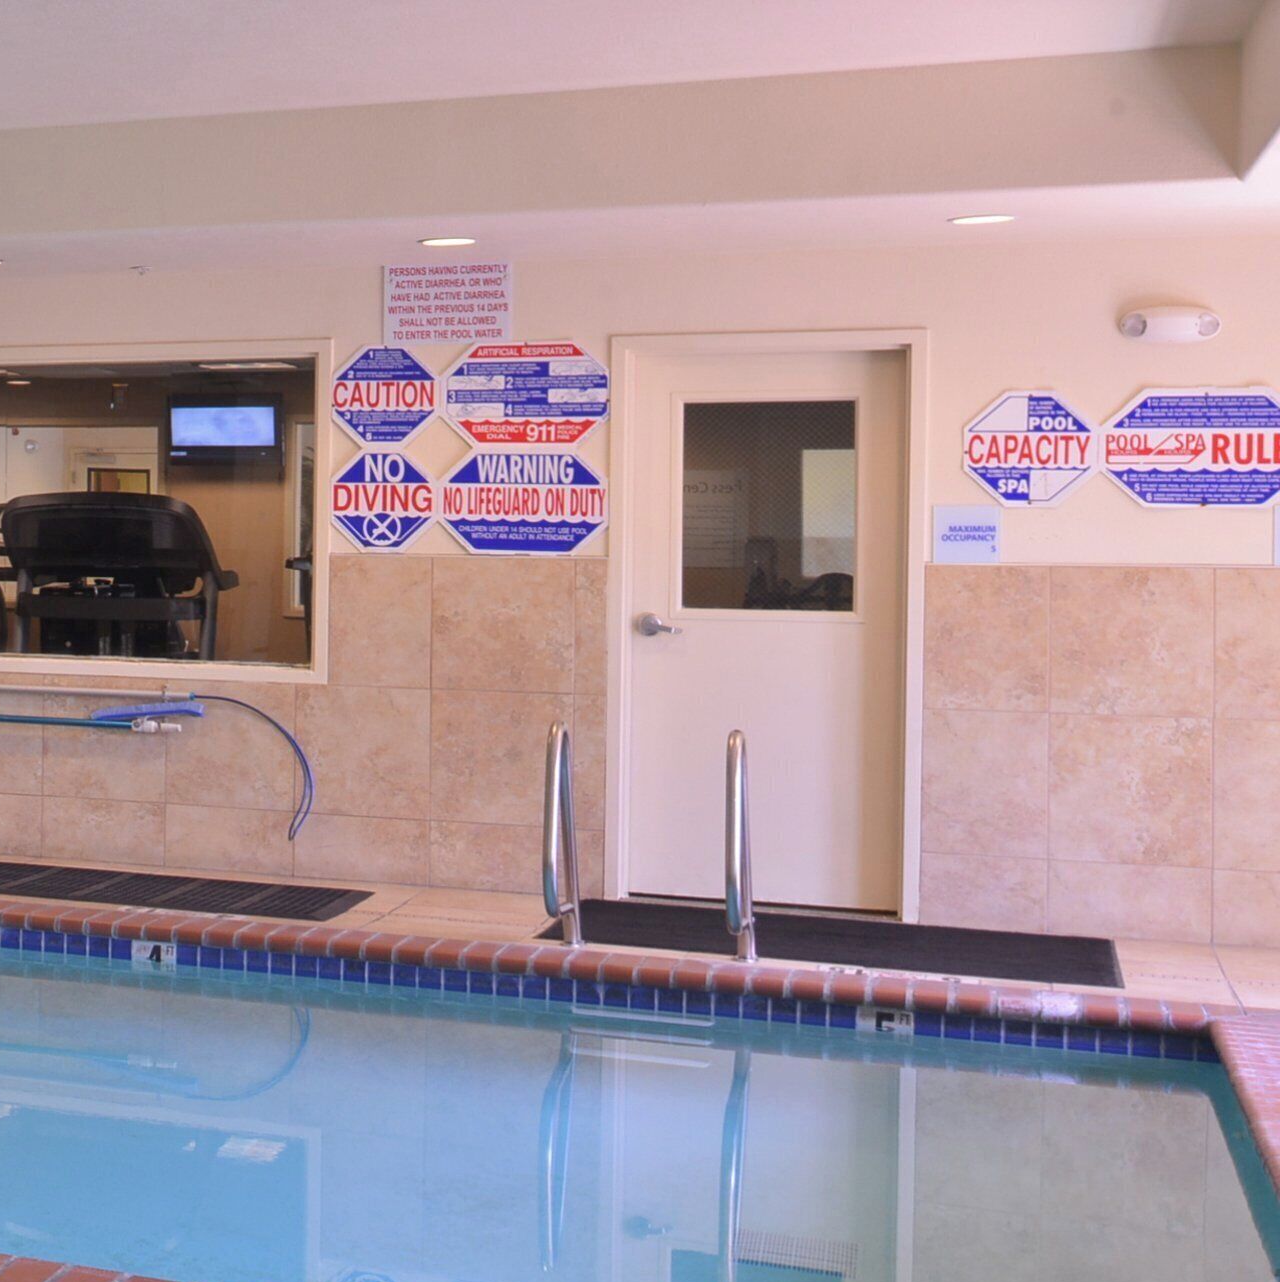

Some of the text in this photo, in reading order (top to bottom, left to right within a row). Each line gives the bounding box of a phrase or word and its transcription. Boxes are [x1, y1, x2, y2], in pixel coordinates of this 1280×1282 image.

[389, 264, 508, 276] PERSONS HAVING CURRENTLY
[395, 277, 502, 289] ACTIVE DIARRHEA OR WHO
[391, 290, 505, 302] HAVE HAD ACTIVE DIARRHEA
[388, 303, 508, 314] WITHIN THE PREVIOUS 14 DAYS
[399, 316, 496, 327] SHALL NOT BE ALLOWED
[393, 328, 502, 340] TO ENTER THE POOL WATER
[477, 345, 573, 356] ARTIFICIAL RESPIRATION
[333, 381, 434, 408] CAUTION
[1029, 416, 1077, 430] POOL
[472, 424, 556, 442] EMERGENCY 911
[968, 435, 1091, 465] CAPACITY
[364, 454, 405, 482] NO
[477, 455, 574, 484] WARNING
[997, 479, 1028, 493] SPA
[333, 484, 432, 512] DIVING
[443, 487, 606, 517] NO LIFEGUARD ON DUTY
